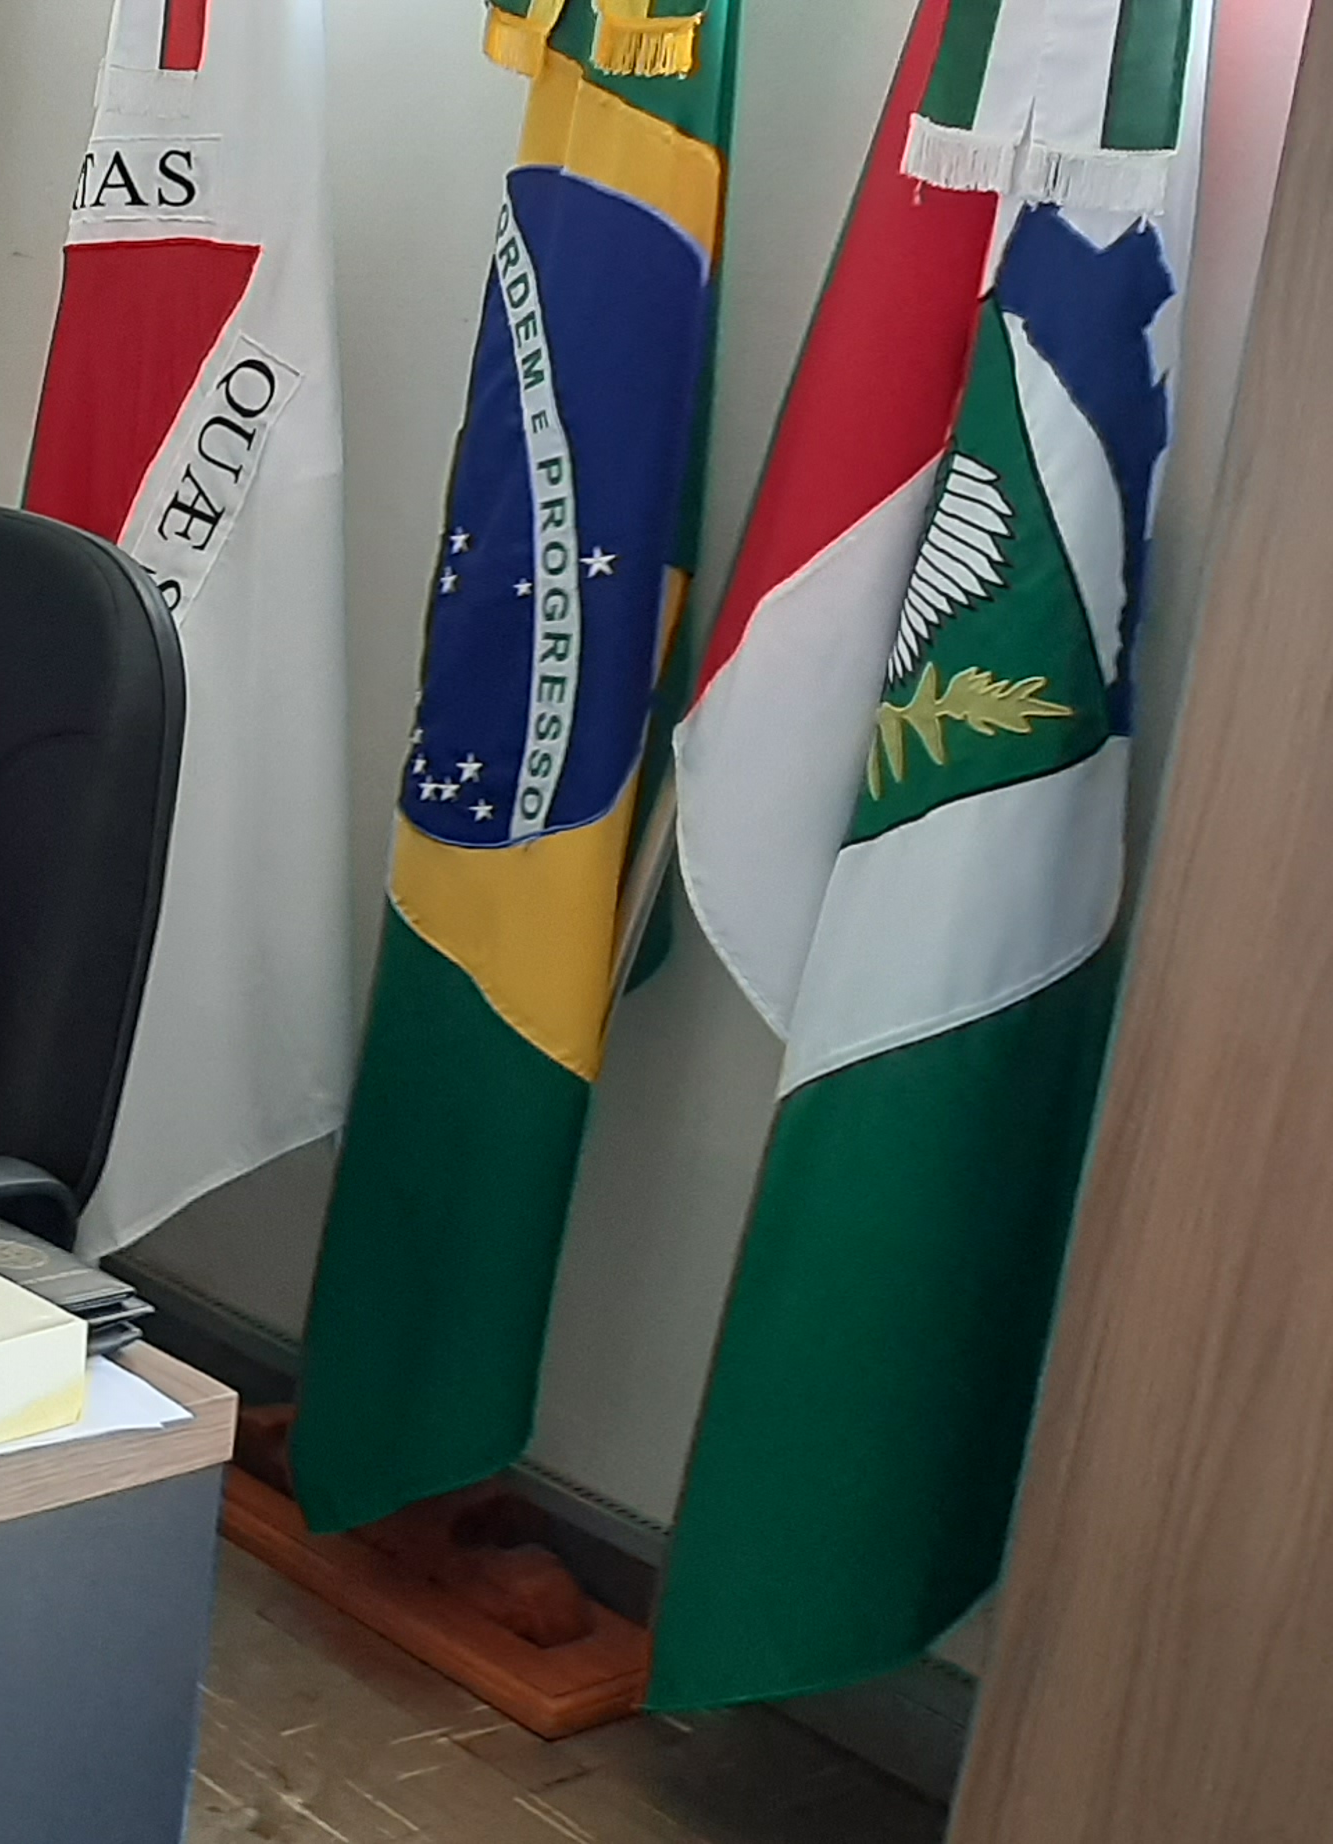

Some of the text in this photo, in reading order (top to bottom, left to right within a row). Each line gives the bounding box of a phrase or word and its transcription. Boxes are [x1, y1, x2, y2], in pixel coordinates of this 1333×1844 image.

[495, 203, 574, 821] ORDEM E PROGRESSO
